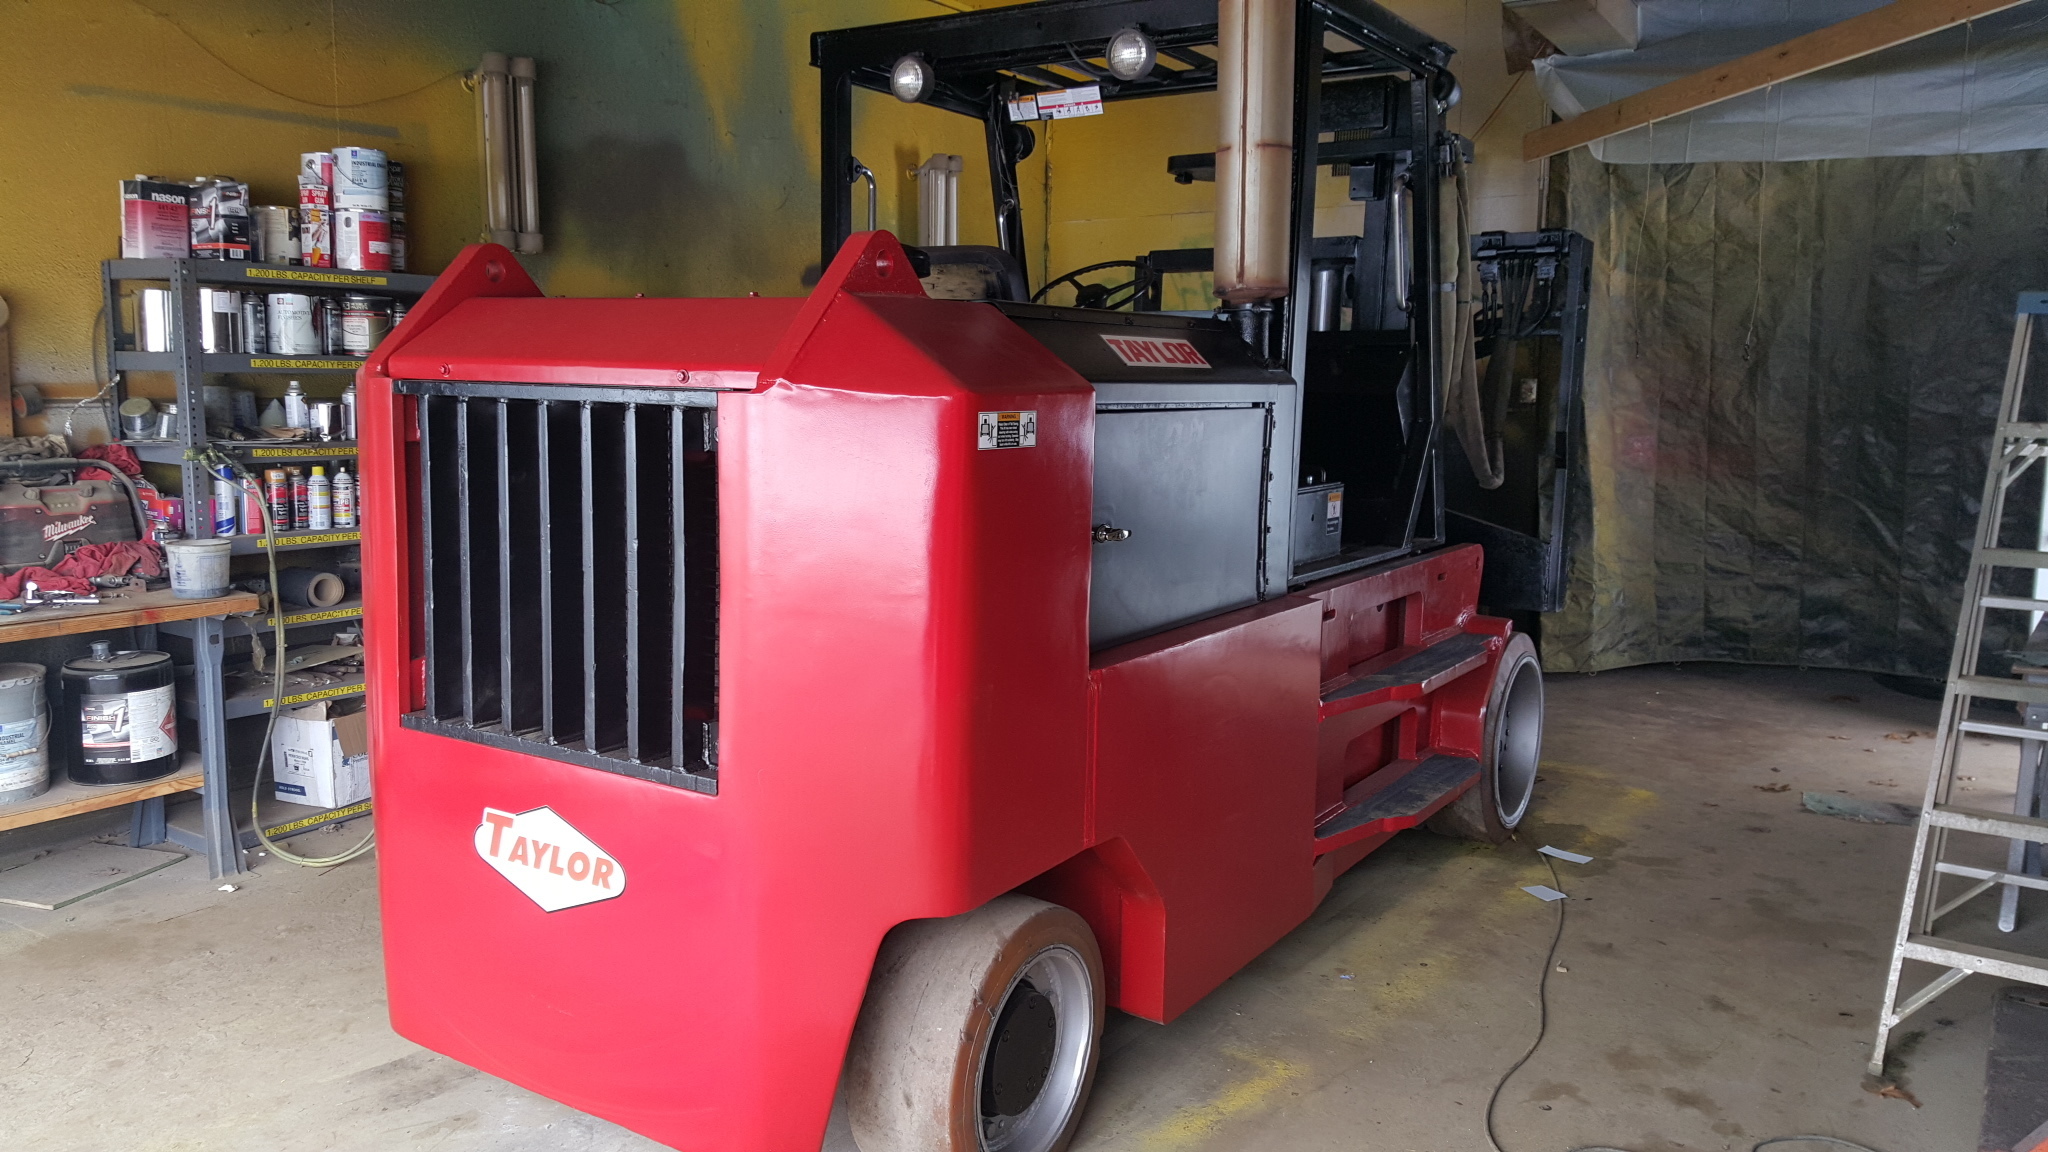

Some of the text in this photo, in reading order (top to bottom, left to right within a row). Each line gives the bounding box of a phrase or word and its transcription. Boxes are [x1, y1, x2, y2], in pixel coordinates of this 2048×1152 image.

[151, 192, 185, 205] nason
[271, 271, 289, 279] LBS.
[291, 272, 331, 282] CAPACITY
[333, 275, 350, 283] PER
[350, 276, 376, 284] SHELF
[1105, 338, 1208, 366] TAYLOR
[276, 360, 293, 368] LBS.
[295, 361, 335, 369] CAPACITY
[337, 361, 353, 369] PER
[296, 448, 336, 456] CAPACITY
[338, 447, 354, 455] PER
[42, 515, 97, 539] Milwaukee
[300, 534, 340, 544] CAPACITY
[342, 532, 358, 540] PER
[310, 609, 350, 621] CAPACITY
[351, 607, 364, 615] PE
[306, 688, 345, 701] CAPACITY
[346, 684, 363, 694] PER
[112, 706, 126, 733] 1
[288, 820, 306, 831] LBS.
[307, 808, 346, 825] CAPACITY
[347, 804, 363, 815] PER
[486, 812, 614, 890] TAYLOR
